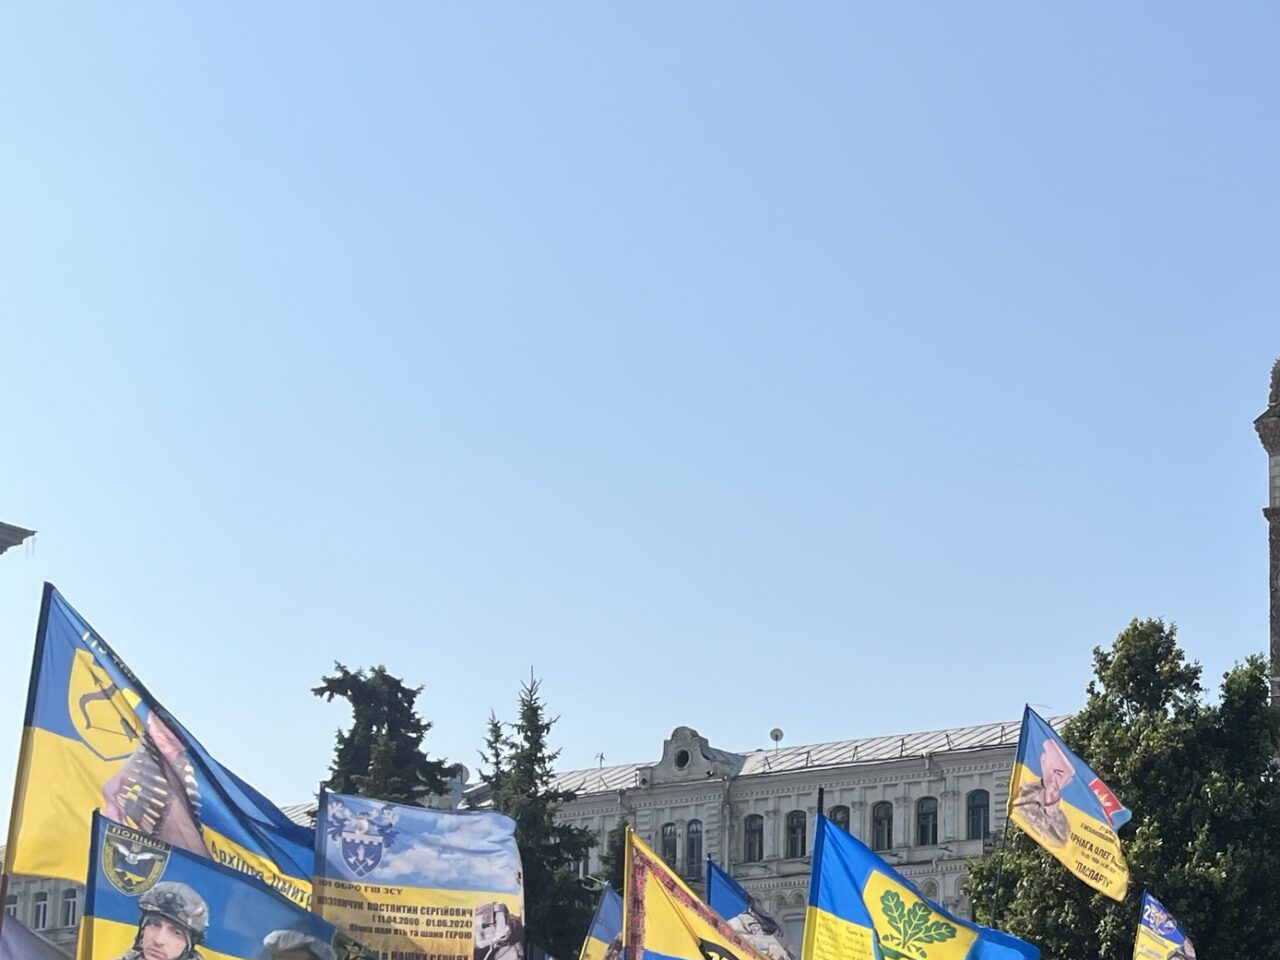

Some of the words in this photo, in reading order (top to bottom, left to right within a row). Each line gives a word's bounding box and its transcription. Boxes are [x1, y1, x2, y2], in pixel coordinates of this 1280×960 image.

[367, 901, 418, 914] КОСТЯНТИН
[420, 905, 474, 918] СЕРГІЙОВИЧ
[445, 930, 472, 940] ГЕРОЮ
